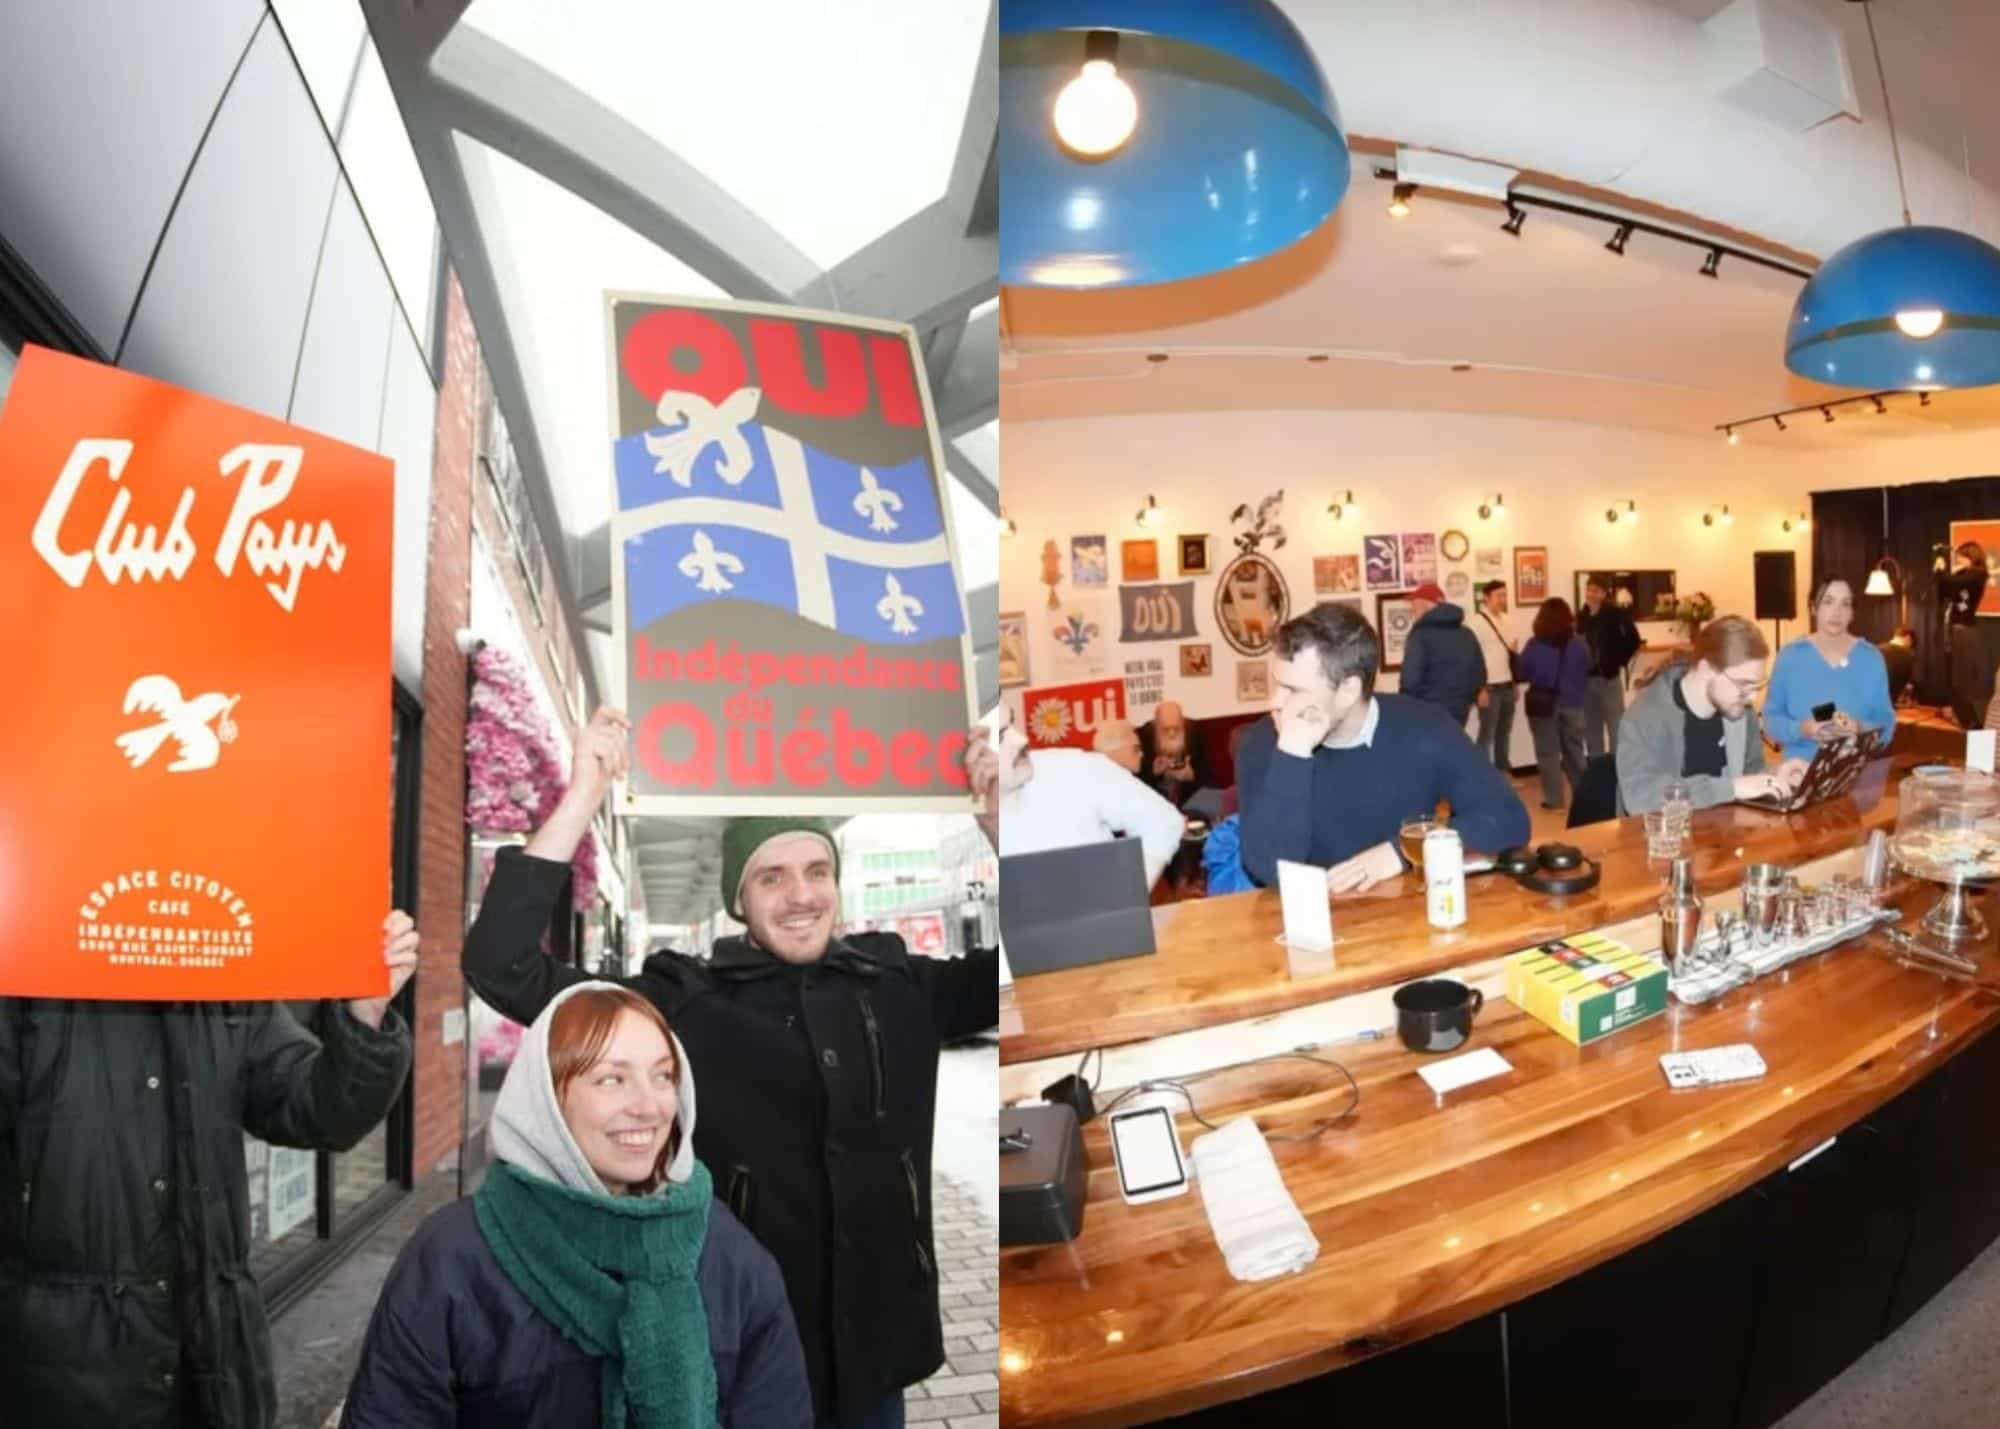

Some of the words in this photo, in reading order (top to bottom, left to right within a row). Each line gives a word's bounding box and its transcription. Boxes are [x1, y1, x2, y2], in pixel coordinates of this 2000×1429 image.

[622, 309, 924, 427] OUI
[32, 438, 197, 589] Club
[214, 442, 347, 612] Pays
[635, 636, 963, 693] Indépendance
[723, 689, 775, 722] du
[637, 702, 969, 790] Québec
[80, 870, 158, 921] ESPACE
[170, 871, 254, 928] CITOYEN
